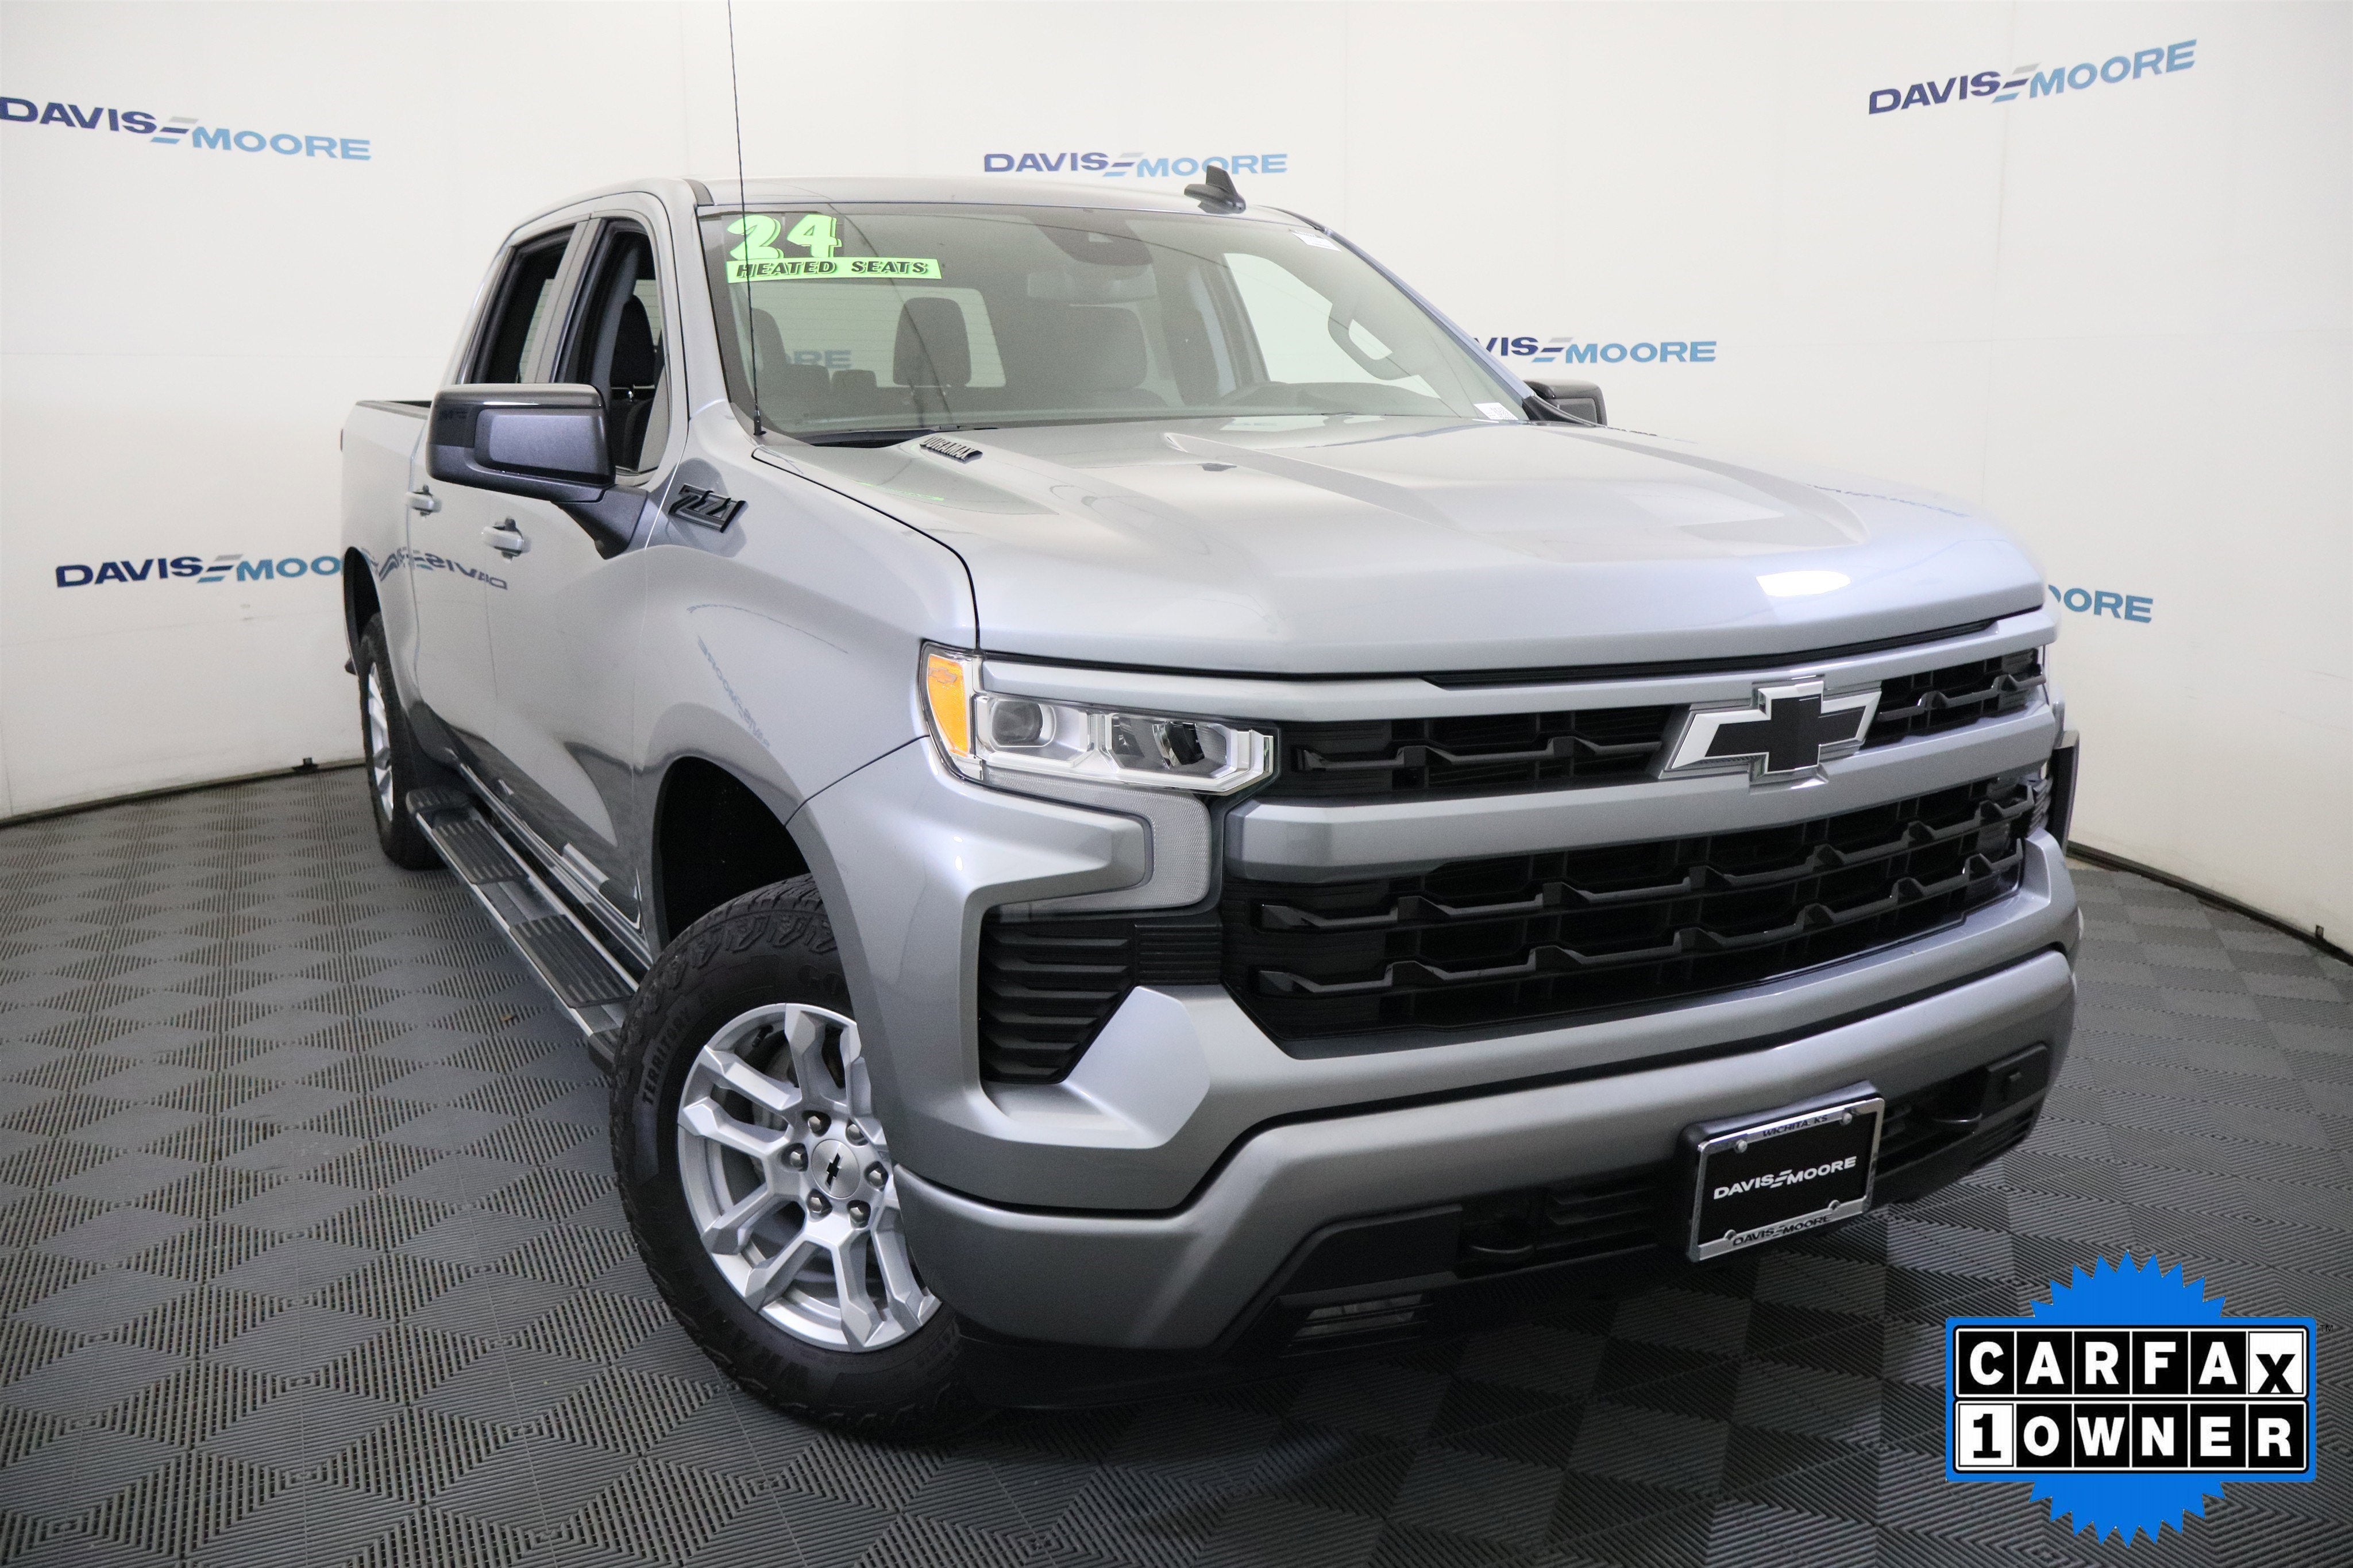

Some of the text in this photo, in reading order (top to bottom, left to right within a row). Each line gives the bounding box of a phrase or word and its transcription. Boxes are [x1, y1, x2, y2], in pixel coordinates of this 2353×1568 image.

[1869, 39, 2197, 115] DAVIS MOORE
[0, 96, 371, 161] DAVIS MOORE
[984, 152, 1287, 177] DAVIS MOORE
[727, 214, 842, 259] 24
[736, 261, 928, 278] HEATED SEATS
[785, 350, 852, 368] RE
[1566, 341, 1717, 364] MOORE
[920, 435, 977, 461] DURAMAX
[668, 483, 747, 533] Z71
[55, 556, 203, 588] DAVIS
[1814, 1114, 1827, 1123] KS
[1714, 1156, 1857, 1200] DAVIS MOORE
[1733, 1212, 1833, 1246] DAVIS MOORE
